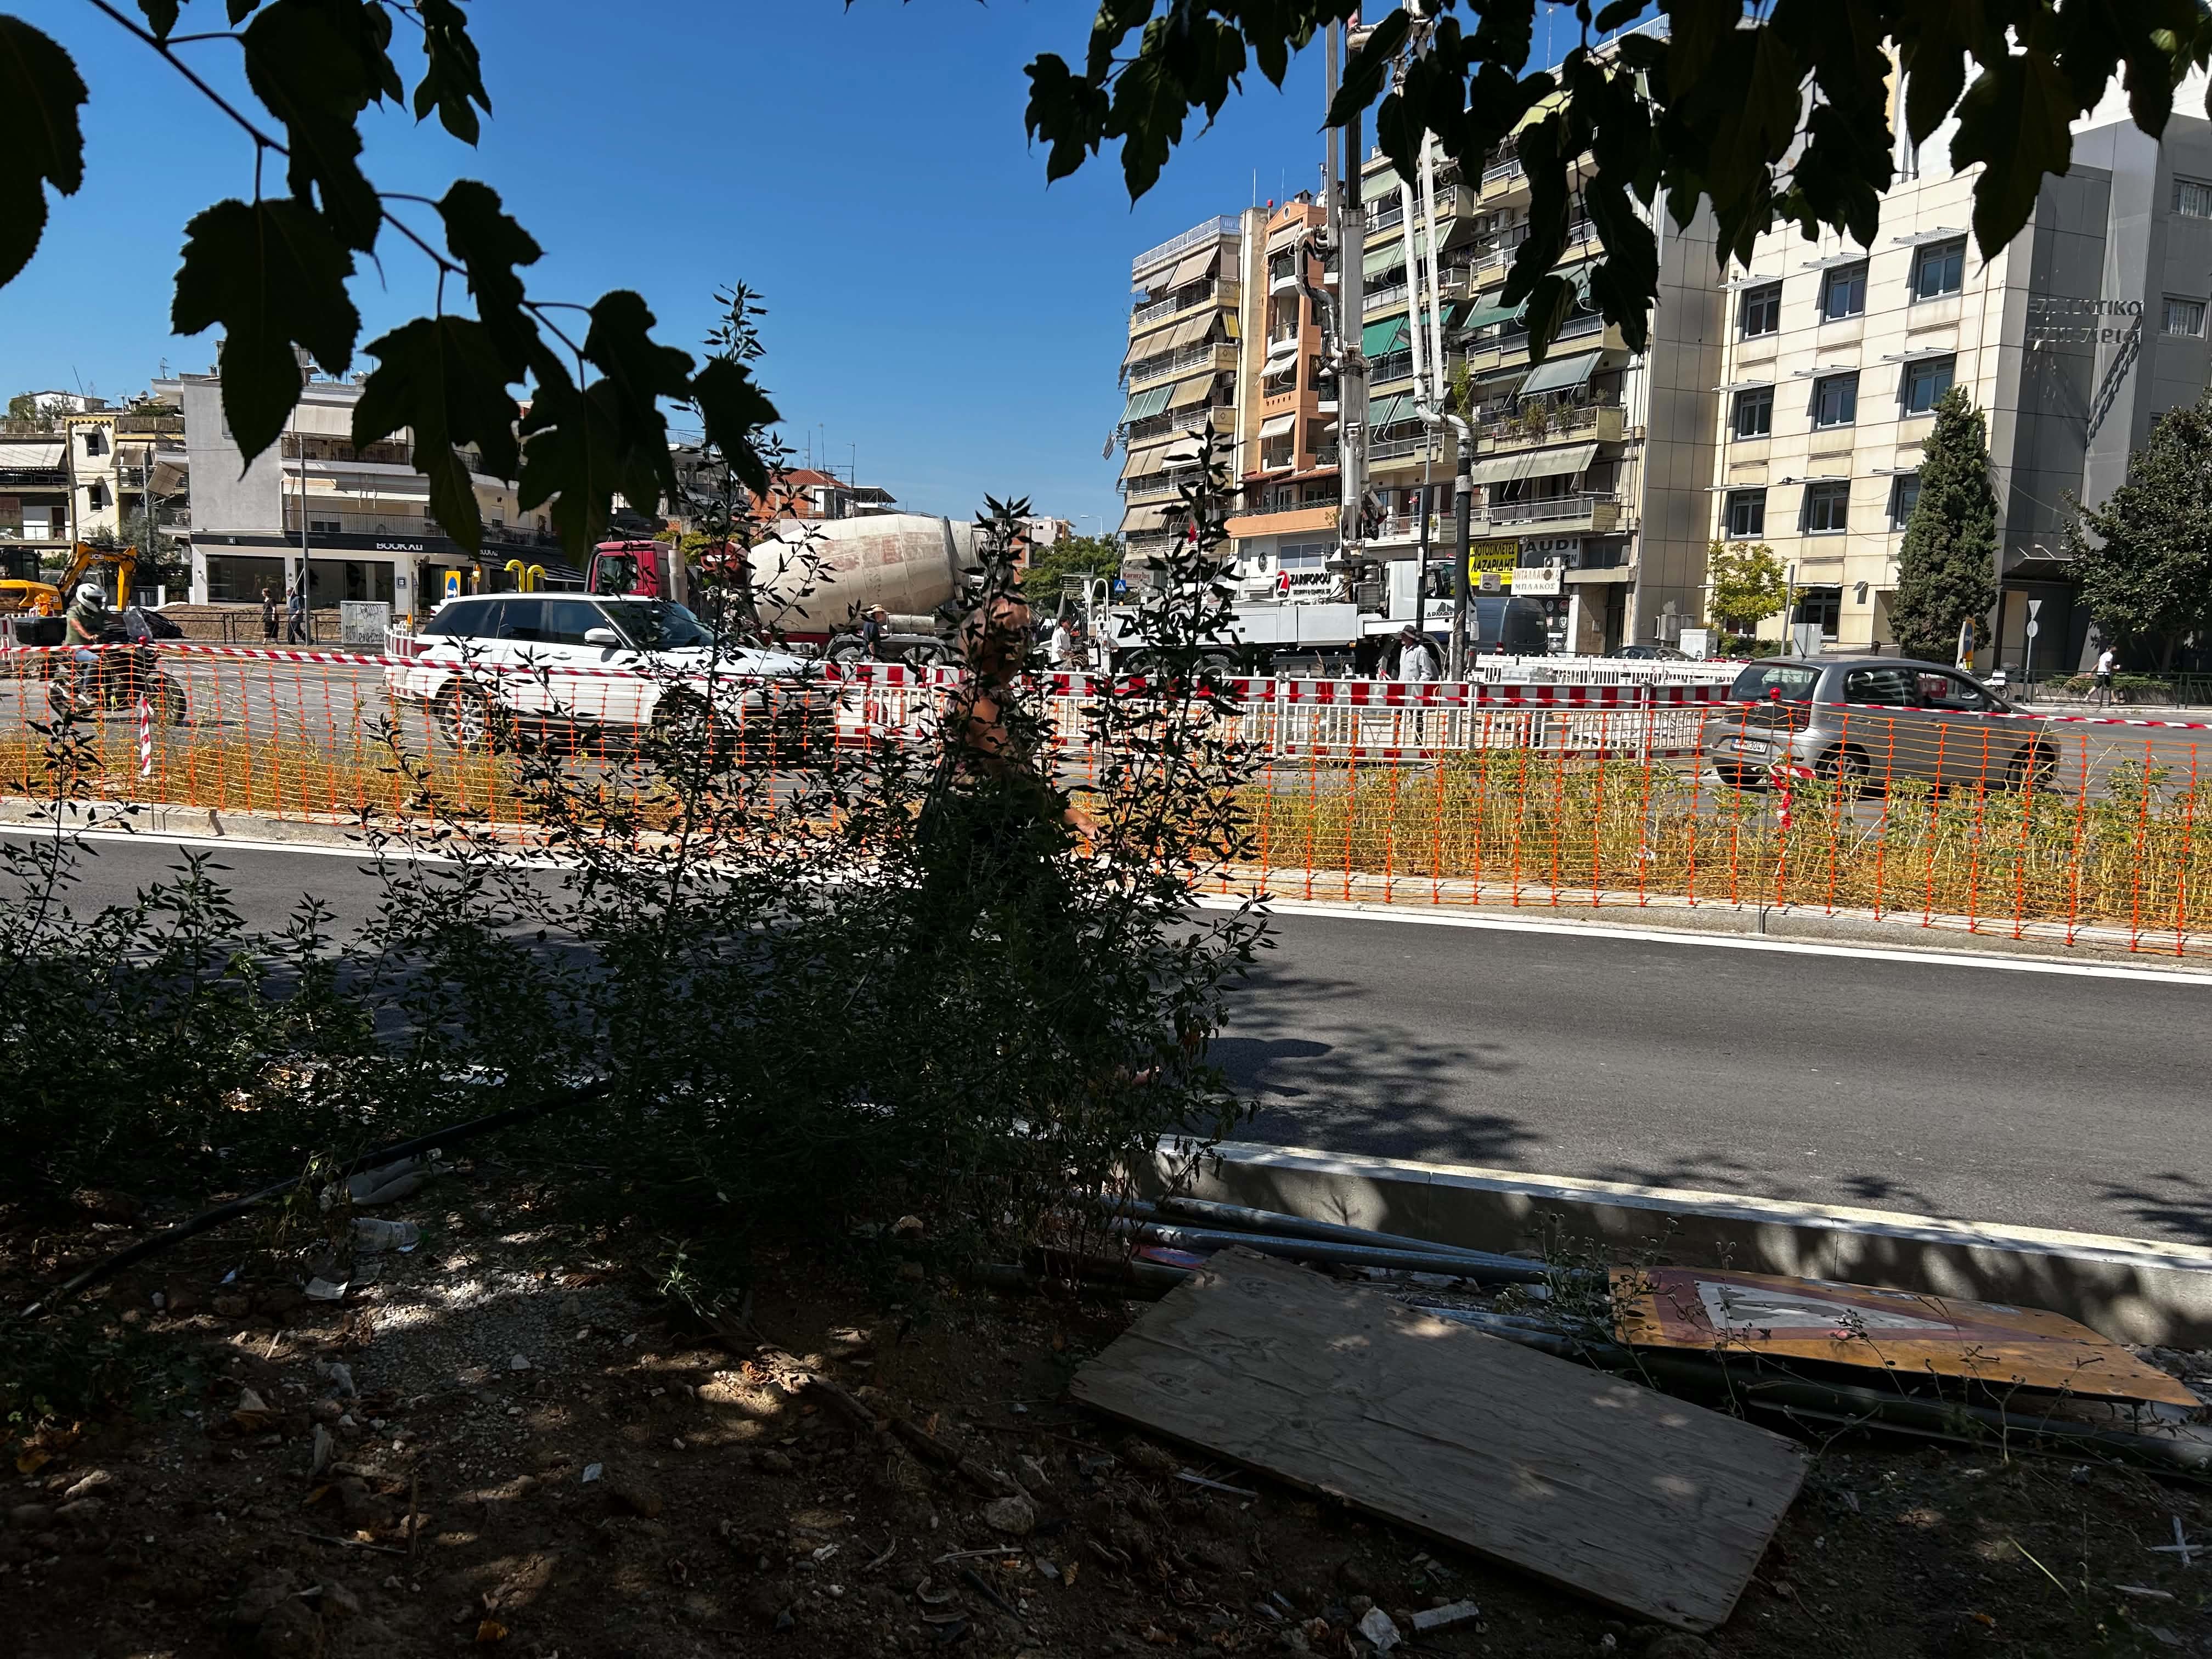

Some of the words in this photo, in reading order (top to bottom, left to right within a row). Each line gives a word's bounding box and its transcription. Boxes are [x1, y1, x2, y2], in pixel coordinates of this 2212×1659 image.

[1525, 538, 1578, 552] AUDI
[1471, 558, 1515, 572] ΛΑΖΑΡΙΔΗΣ
[1513, 569, 1559, 580] ΑΝΤΑΛΛΑΚΚΑ
